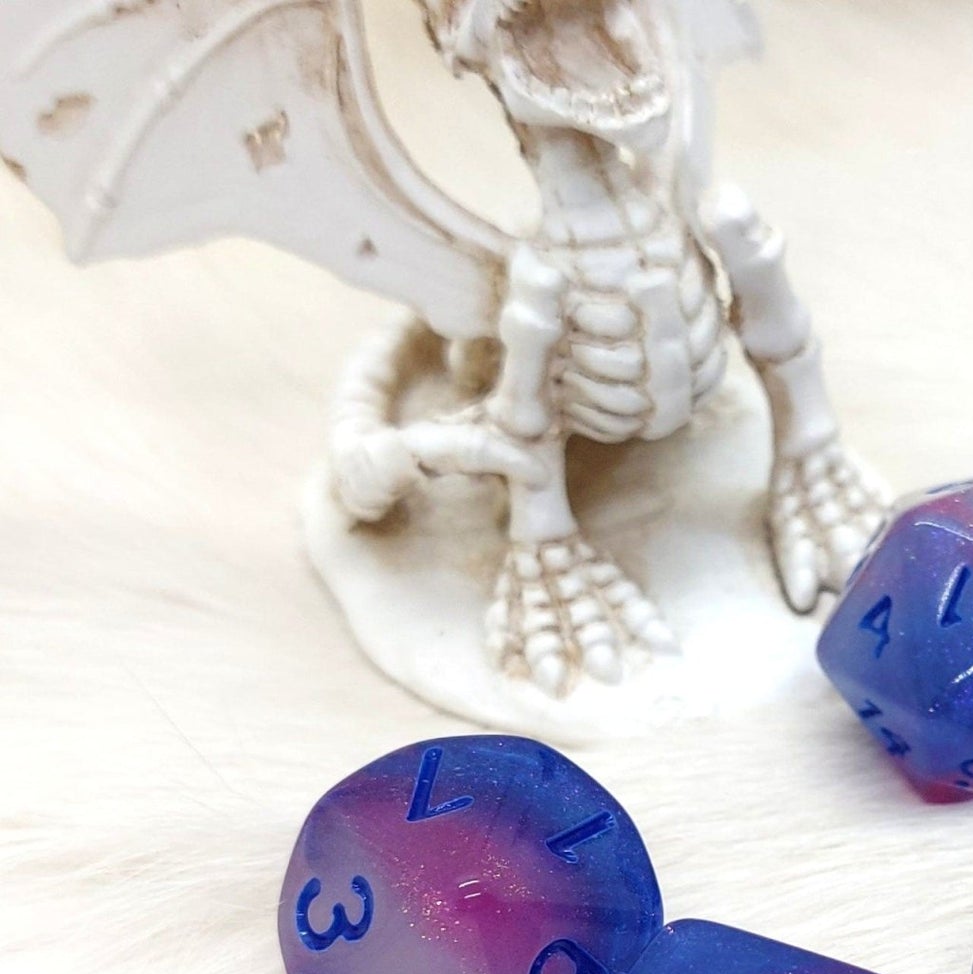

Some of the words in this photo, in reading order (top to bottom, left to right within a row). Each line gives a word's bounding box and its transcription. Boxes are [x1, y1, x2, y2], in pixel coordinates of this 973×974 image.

[859, 595, 893, 659] 4
[406, 747, 475, 822] 7
[544, 810, 616, 864] 1
[295, 875, 375, 952] 3
